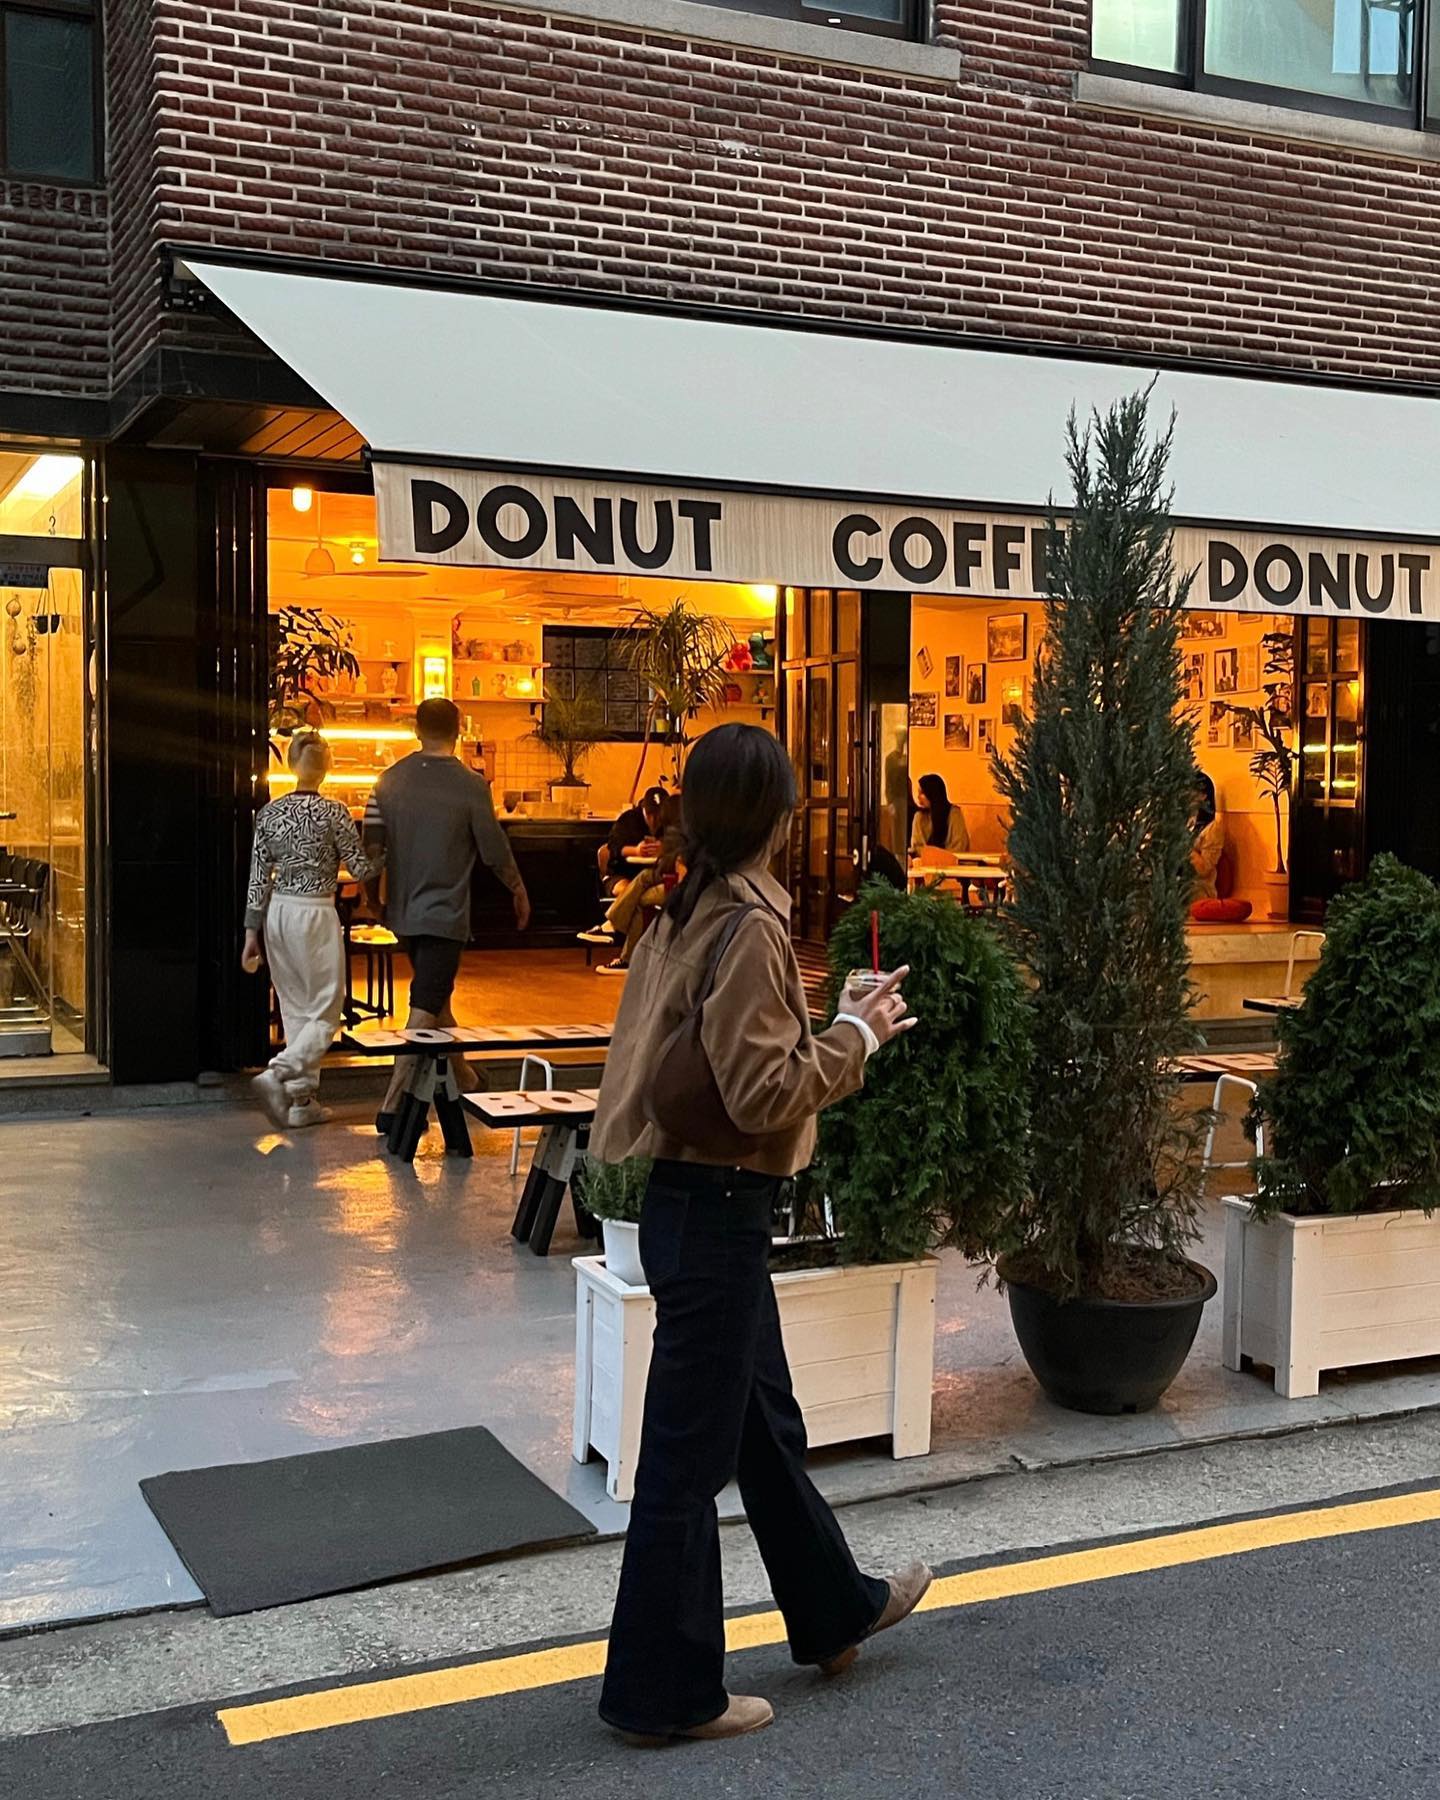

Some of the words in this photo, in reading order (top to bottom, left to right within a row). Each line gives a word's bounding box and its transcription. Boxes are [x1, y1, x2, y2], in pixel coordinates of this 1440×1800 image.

[411, 479, 722, 571] DONUT
[833, 514, 1068, 592] COFFE
[1209, 541, 1431, 615] DONUT
